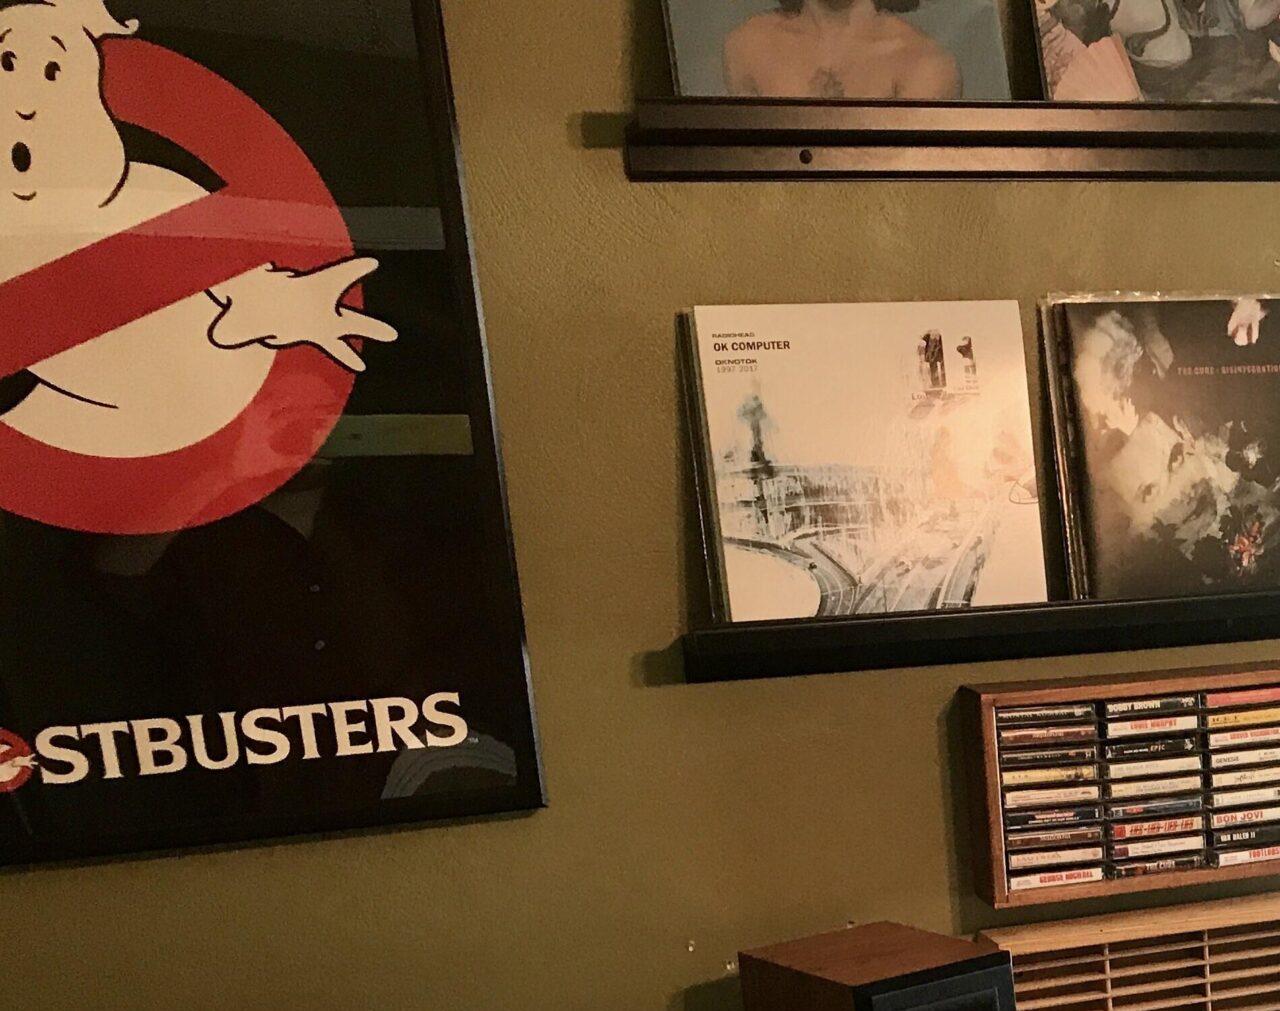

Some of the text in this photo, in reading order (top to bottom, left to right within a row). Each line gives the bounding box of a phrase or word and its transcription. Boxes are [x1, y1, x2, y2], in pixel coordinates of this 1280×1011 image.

[713, 340, 791, 352] OK COMPUTER
[1107, 700, 1161, 713] BOBBY BROWN
[1216, 810, 1264, 824] BON JOVI
